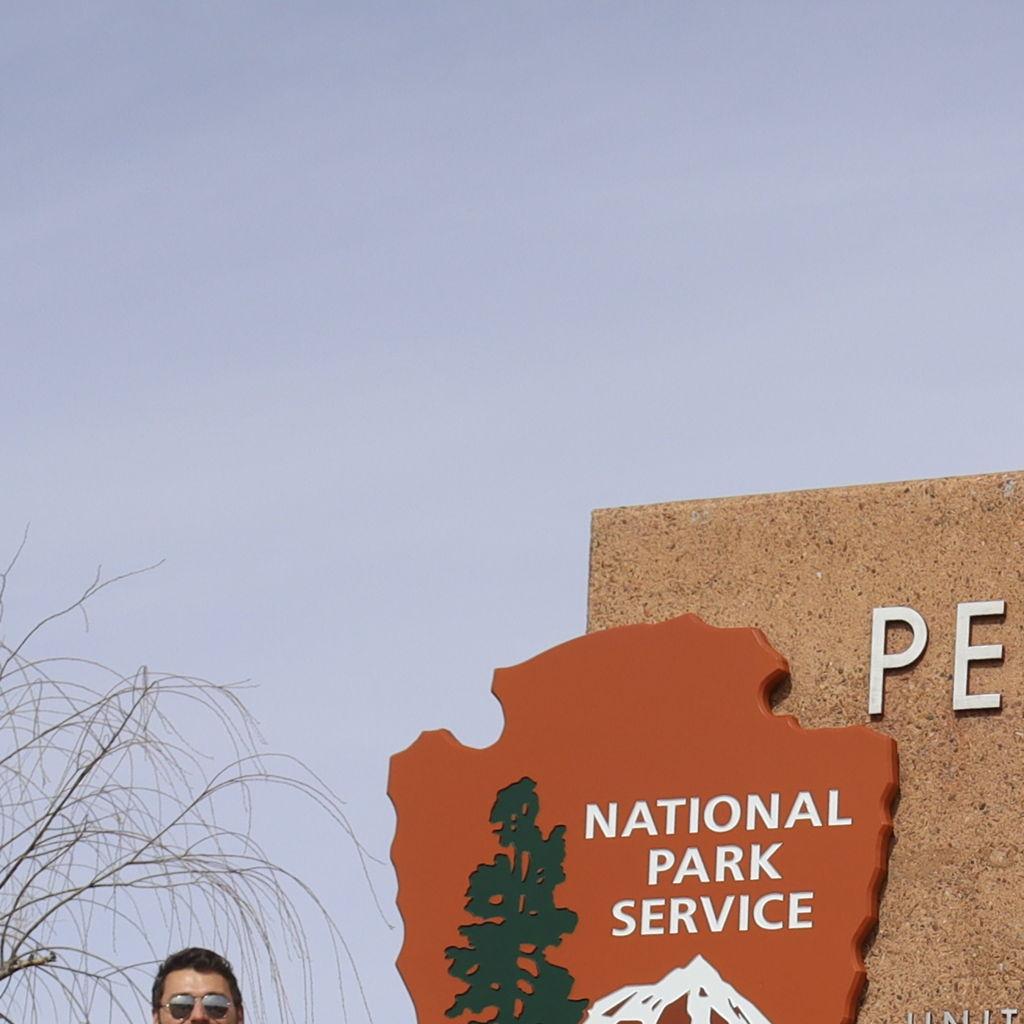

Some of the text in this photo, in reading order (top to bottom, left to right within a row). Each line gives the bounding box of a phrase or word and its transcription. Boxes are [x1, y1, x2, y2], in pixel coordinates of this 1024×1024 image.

[584, 789, 853, 840] NATIONAL
[648, 842, 783, 886] PARK
[611, 892, 814, 937] SERVICE
